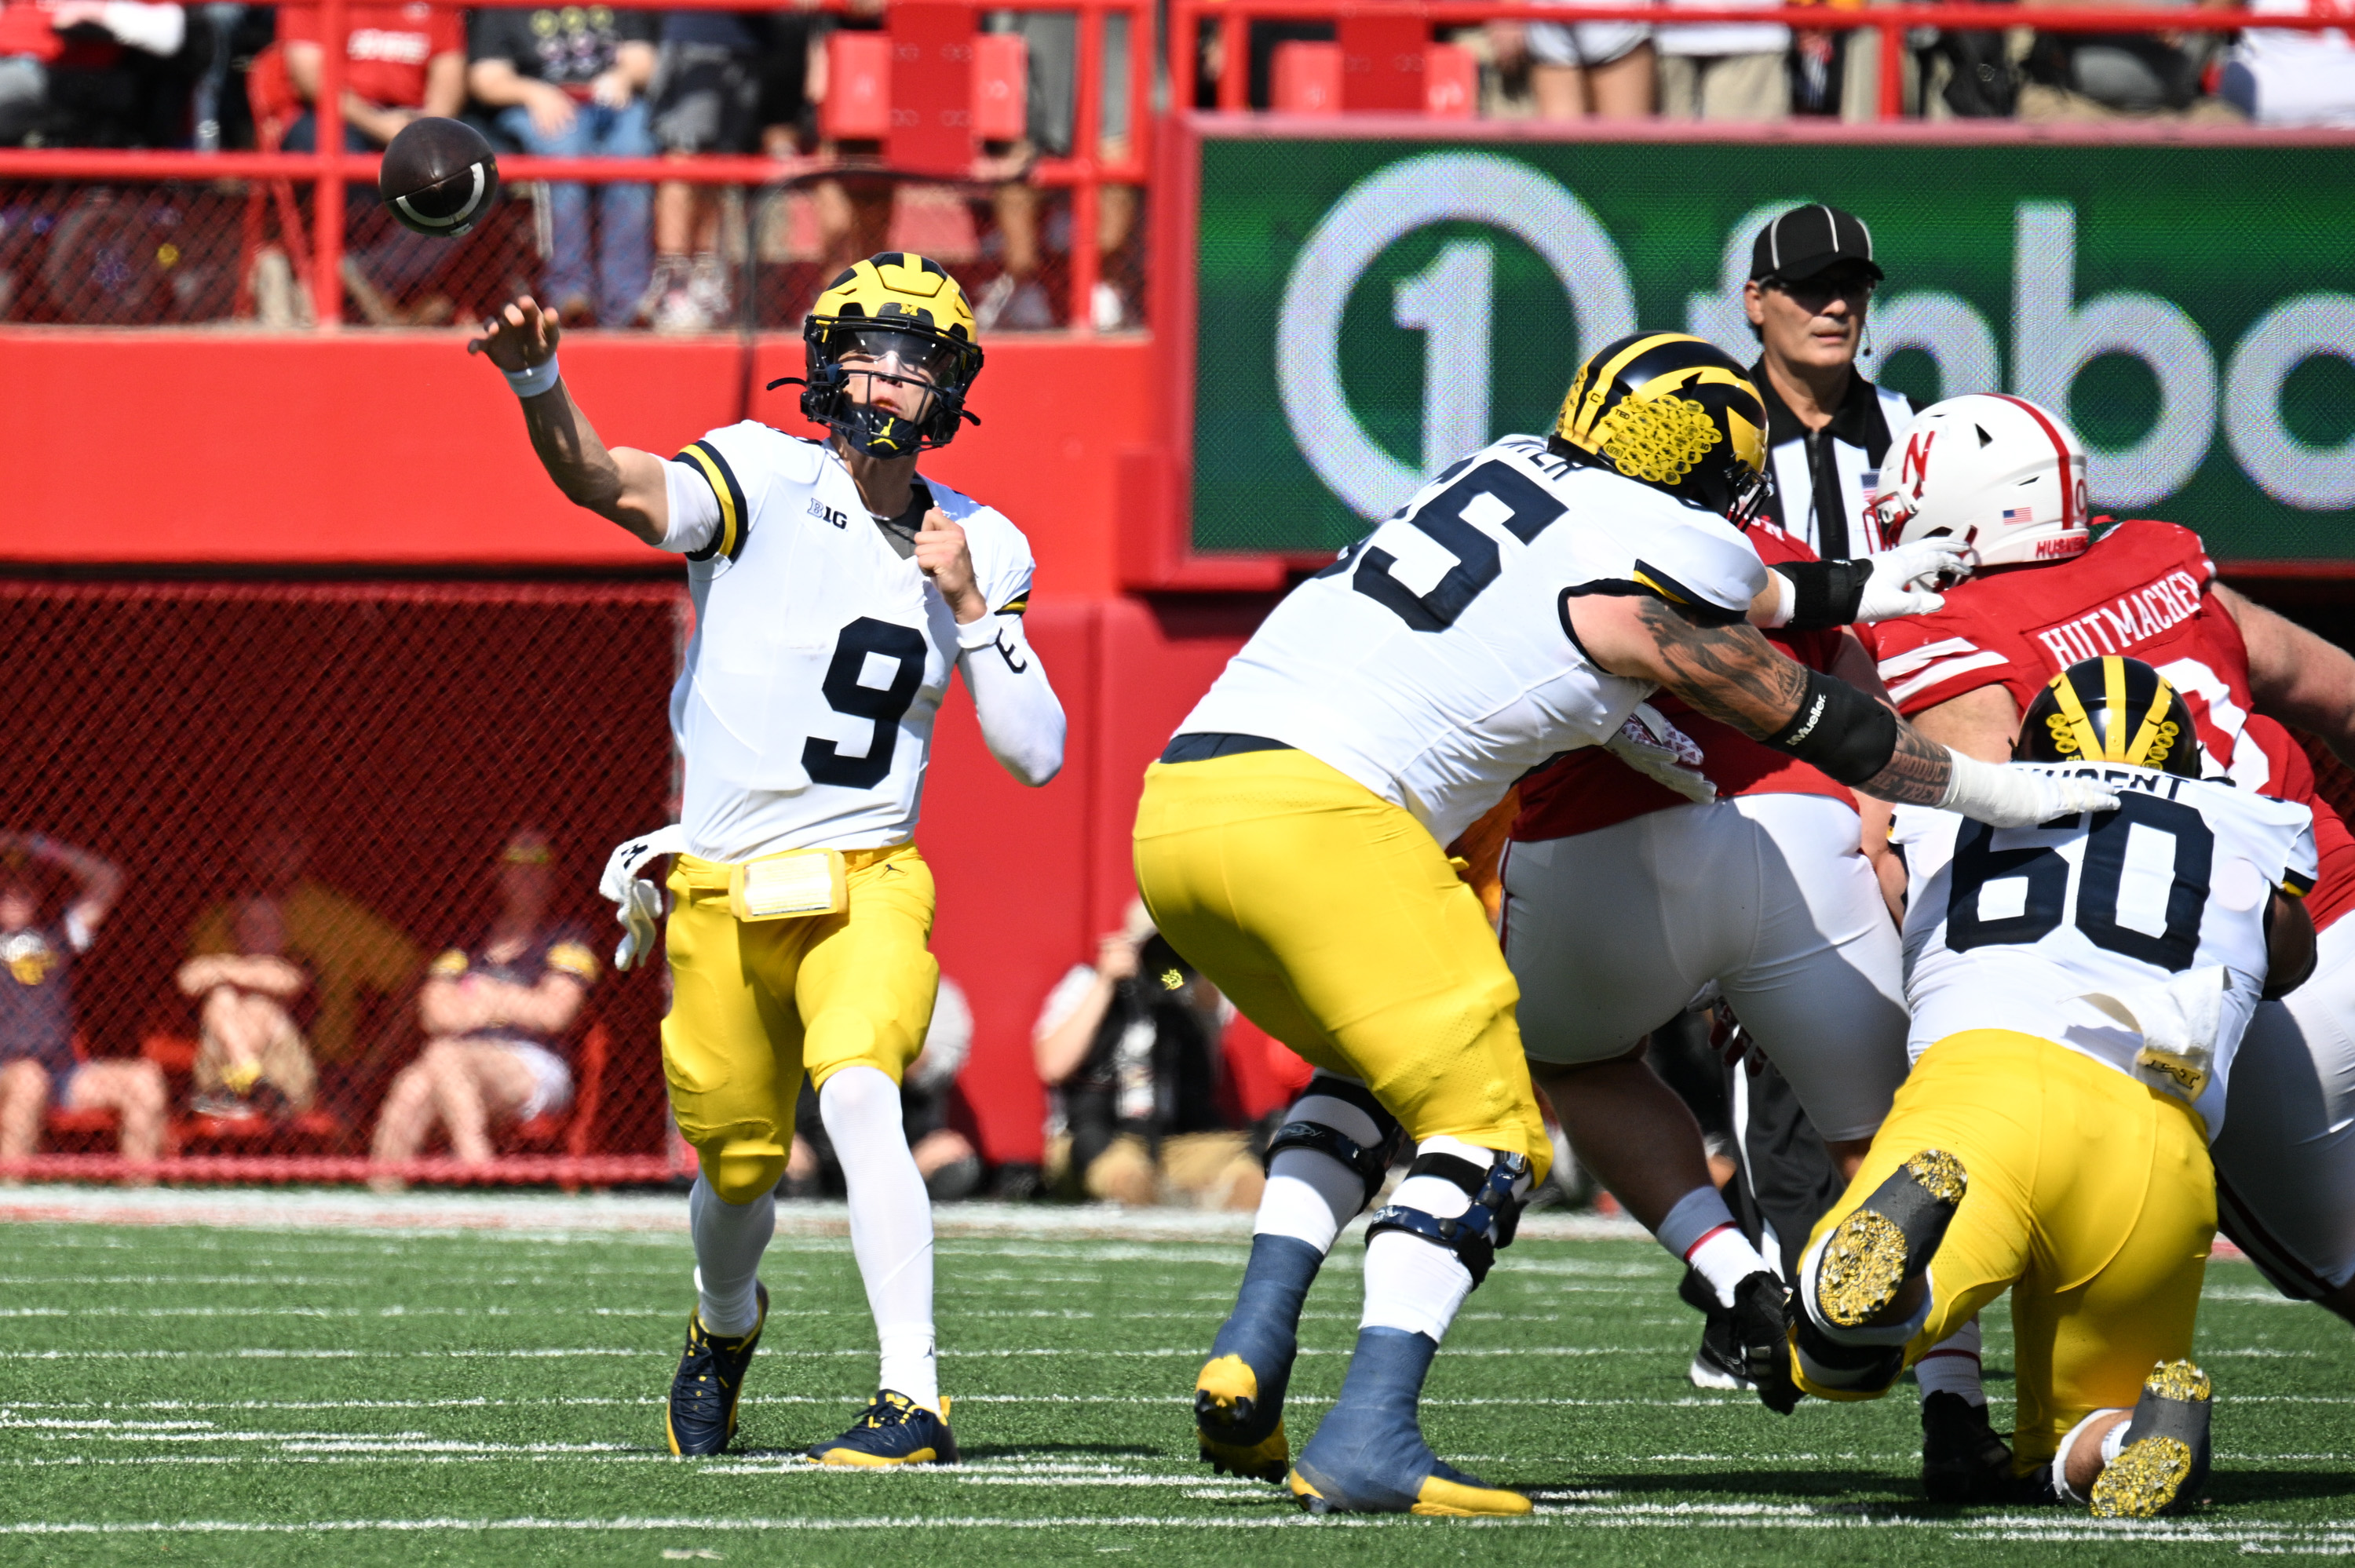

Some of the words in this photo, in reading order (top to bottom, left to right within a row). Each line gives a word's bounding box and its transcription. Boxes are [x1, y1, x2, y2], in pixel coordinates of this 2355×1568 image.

[1616, 408, 1630, 420] TED
[1902, 431, 1936, 483] N
[2037, 571, 2202, 673] HUTMACHER
[801, 616, 928, 790] 9
[1945, 789, 2215, 974] 60
